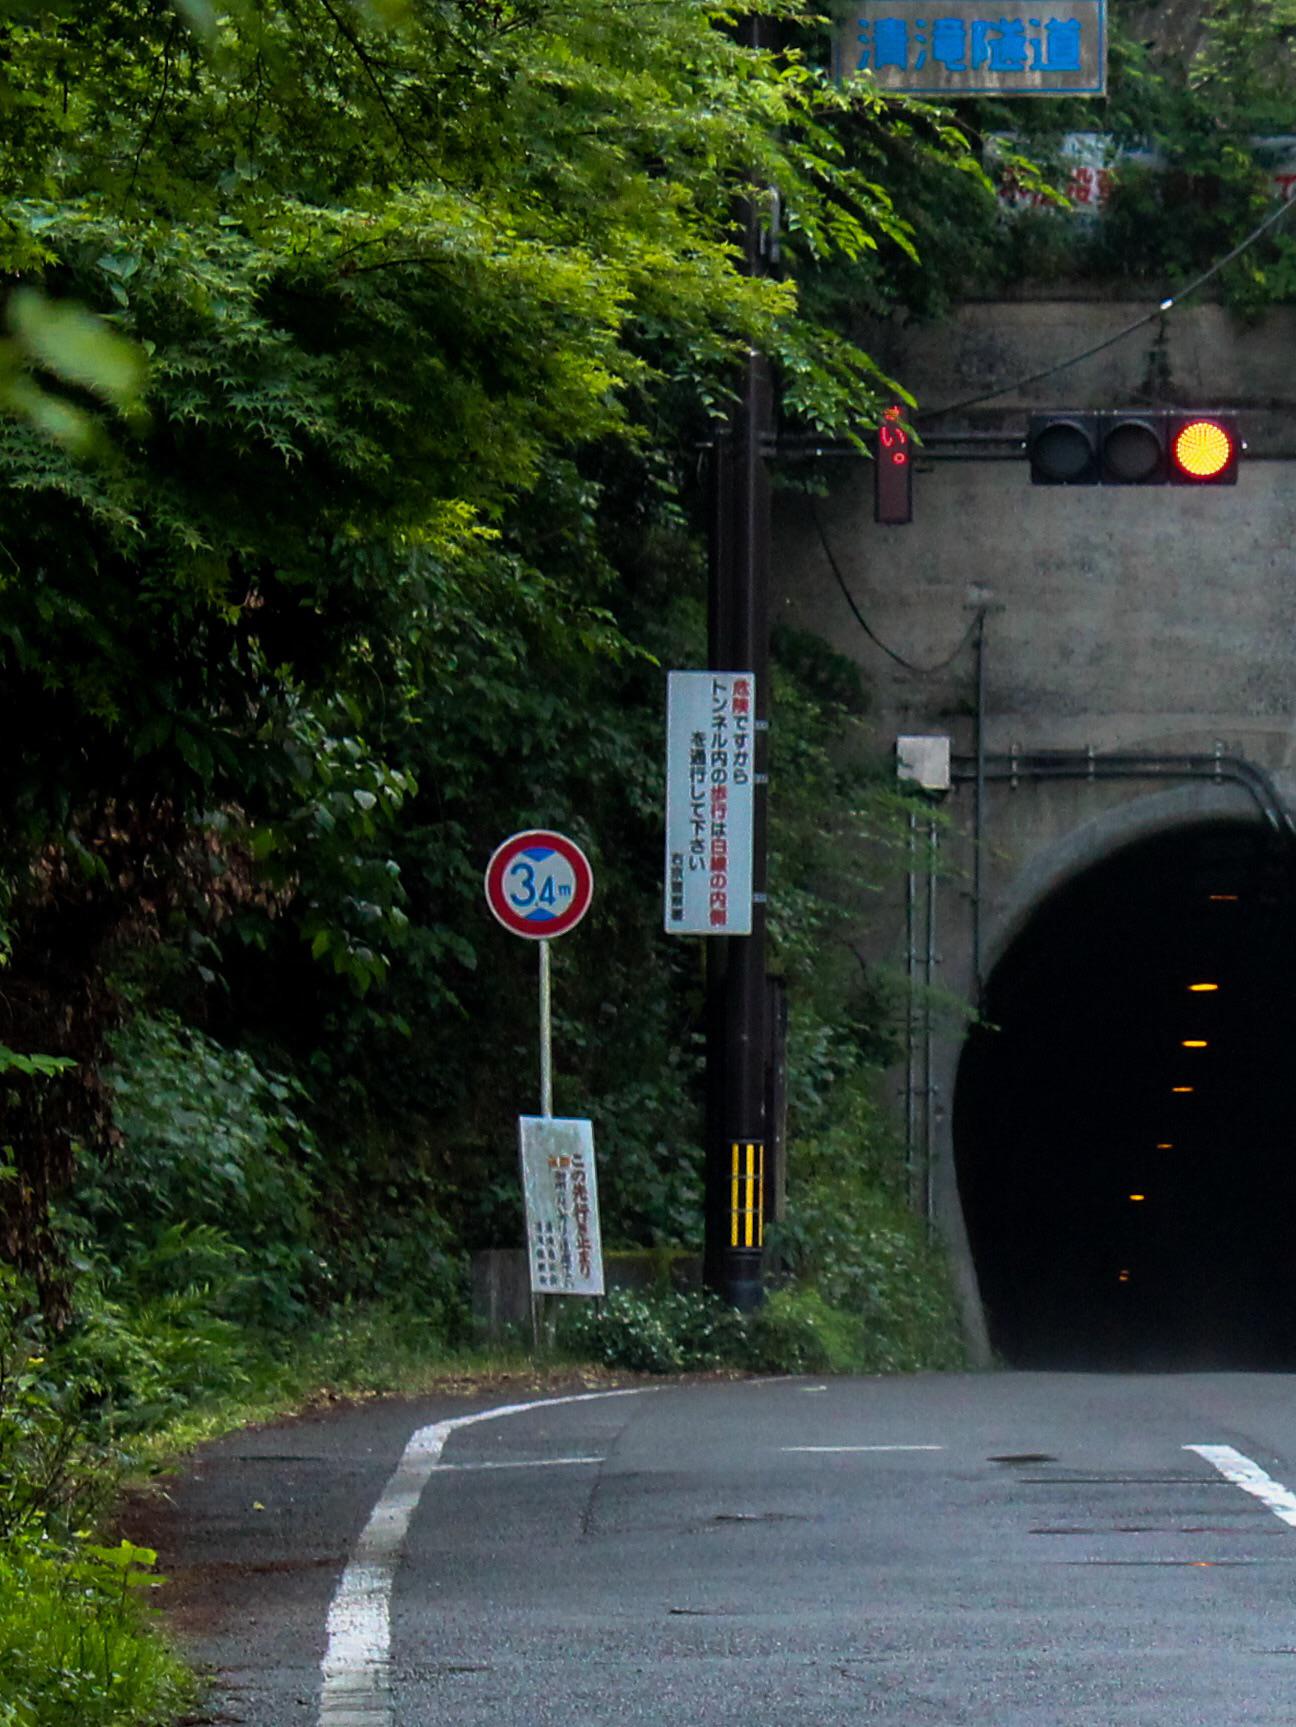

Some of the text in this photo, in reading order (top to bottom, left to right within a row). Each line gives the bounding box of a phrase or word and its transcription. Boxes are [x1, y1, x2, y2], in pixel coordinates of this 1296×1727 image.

[689, 730, 706, 871] を通行して下さい
[732, 679, 750, 784] 危険ですから
[710, 678, 728, 927] トンネル内の歩行は白線の内側
